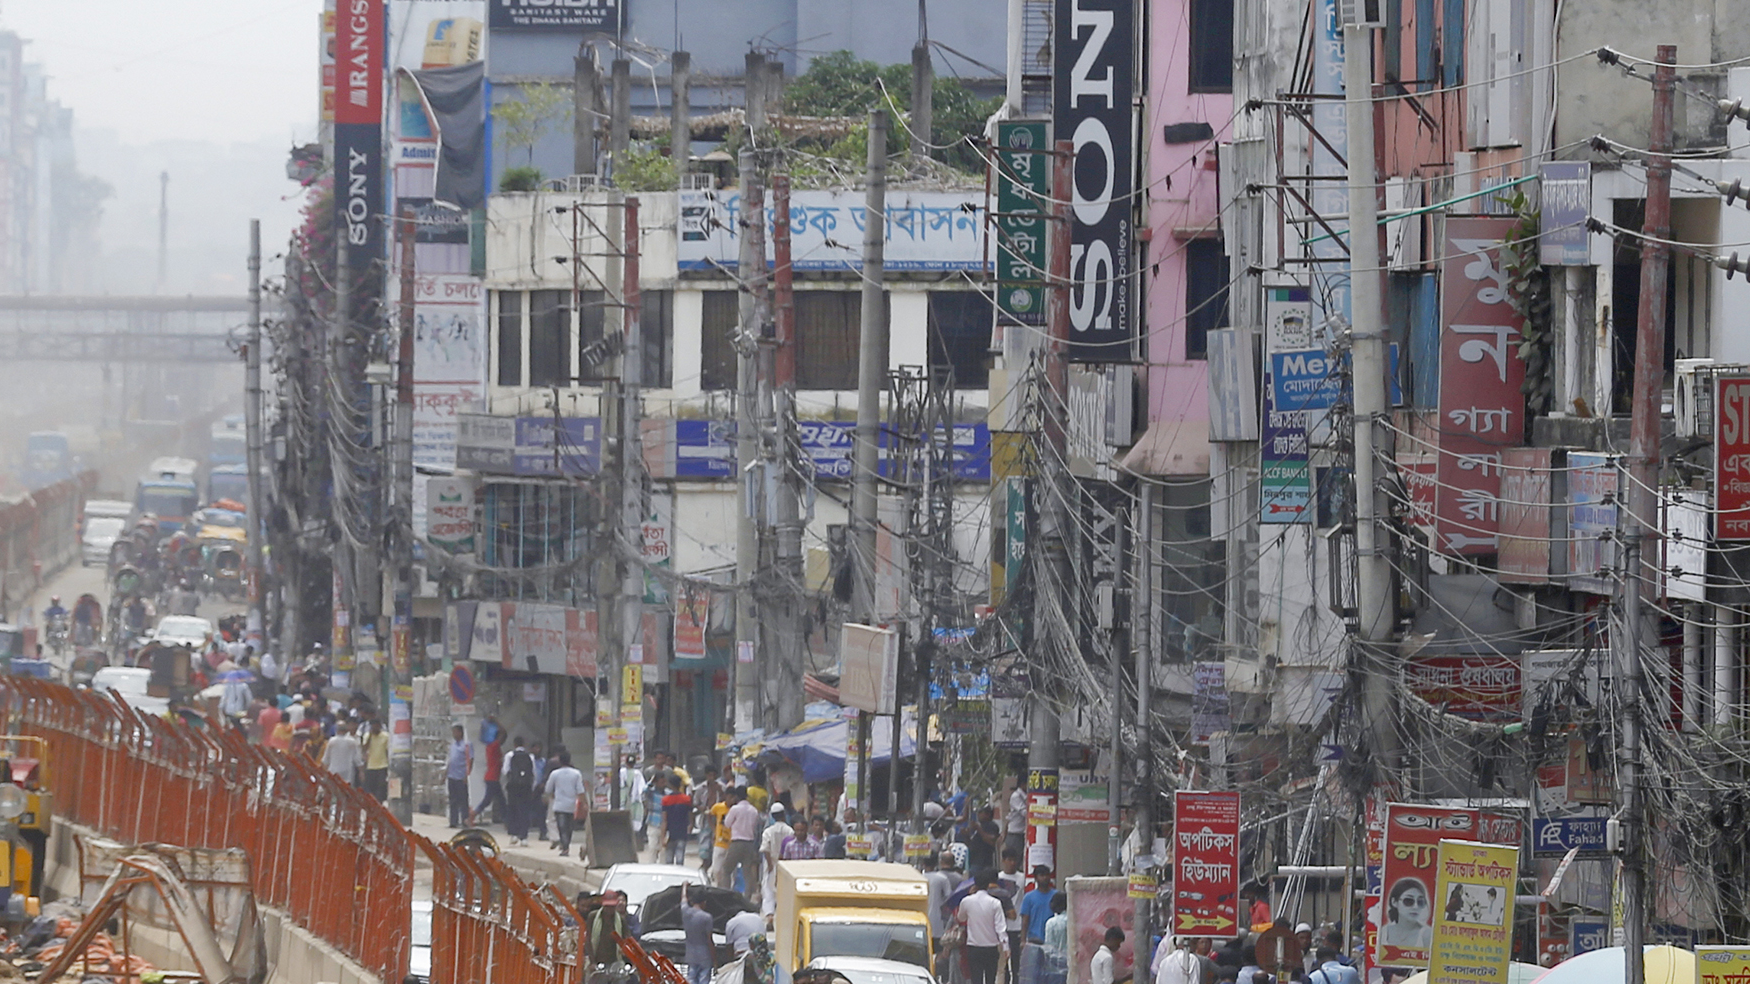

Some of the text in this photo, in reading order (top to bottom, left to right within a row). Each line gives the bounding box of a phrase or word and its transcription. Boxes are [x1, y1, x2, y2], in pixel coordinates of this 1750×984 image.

[348, 146, 368, 246] SONY
[1178, 825, 1235, 857] অপটিকস্
[1568, 834, 1604, 844] Fahad
[1180, 856, 1232, 884] হিউম্যান
[1443, 964, 1499, 977] কনসালটেন্ট
